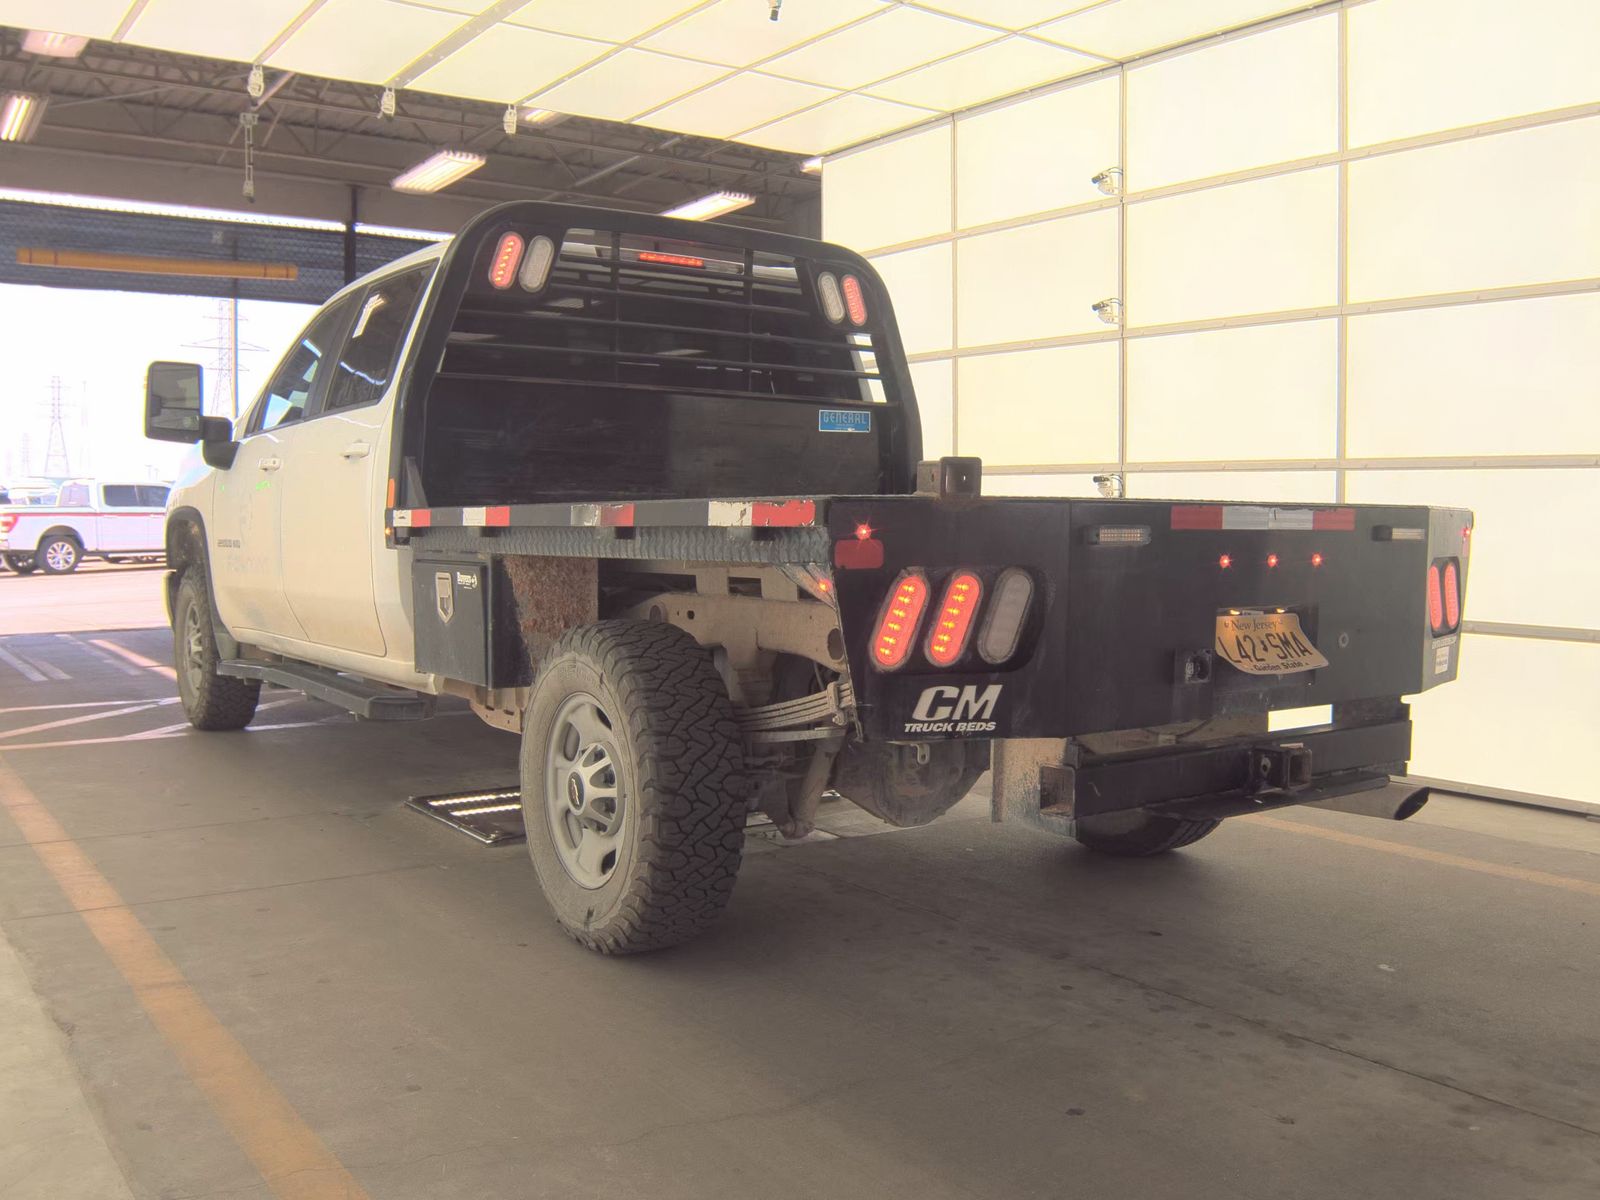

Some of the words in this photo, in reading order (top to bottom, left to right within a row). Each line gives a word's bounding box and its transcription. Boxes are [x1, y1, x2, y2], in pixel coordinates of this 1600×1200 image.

[823, 411, 868, 424] GENERAL
[1231, 620, 1251, 632] New
[1252, 619, 1278, 632] Jersey
[1264, 631, 1313, 660] SMA
[912, 684, 1003, 721] CM
[904, 722, 953, 733] TRUCK
[955, 721, 997, 732] BEDS
